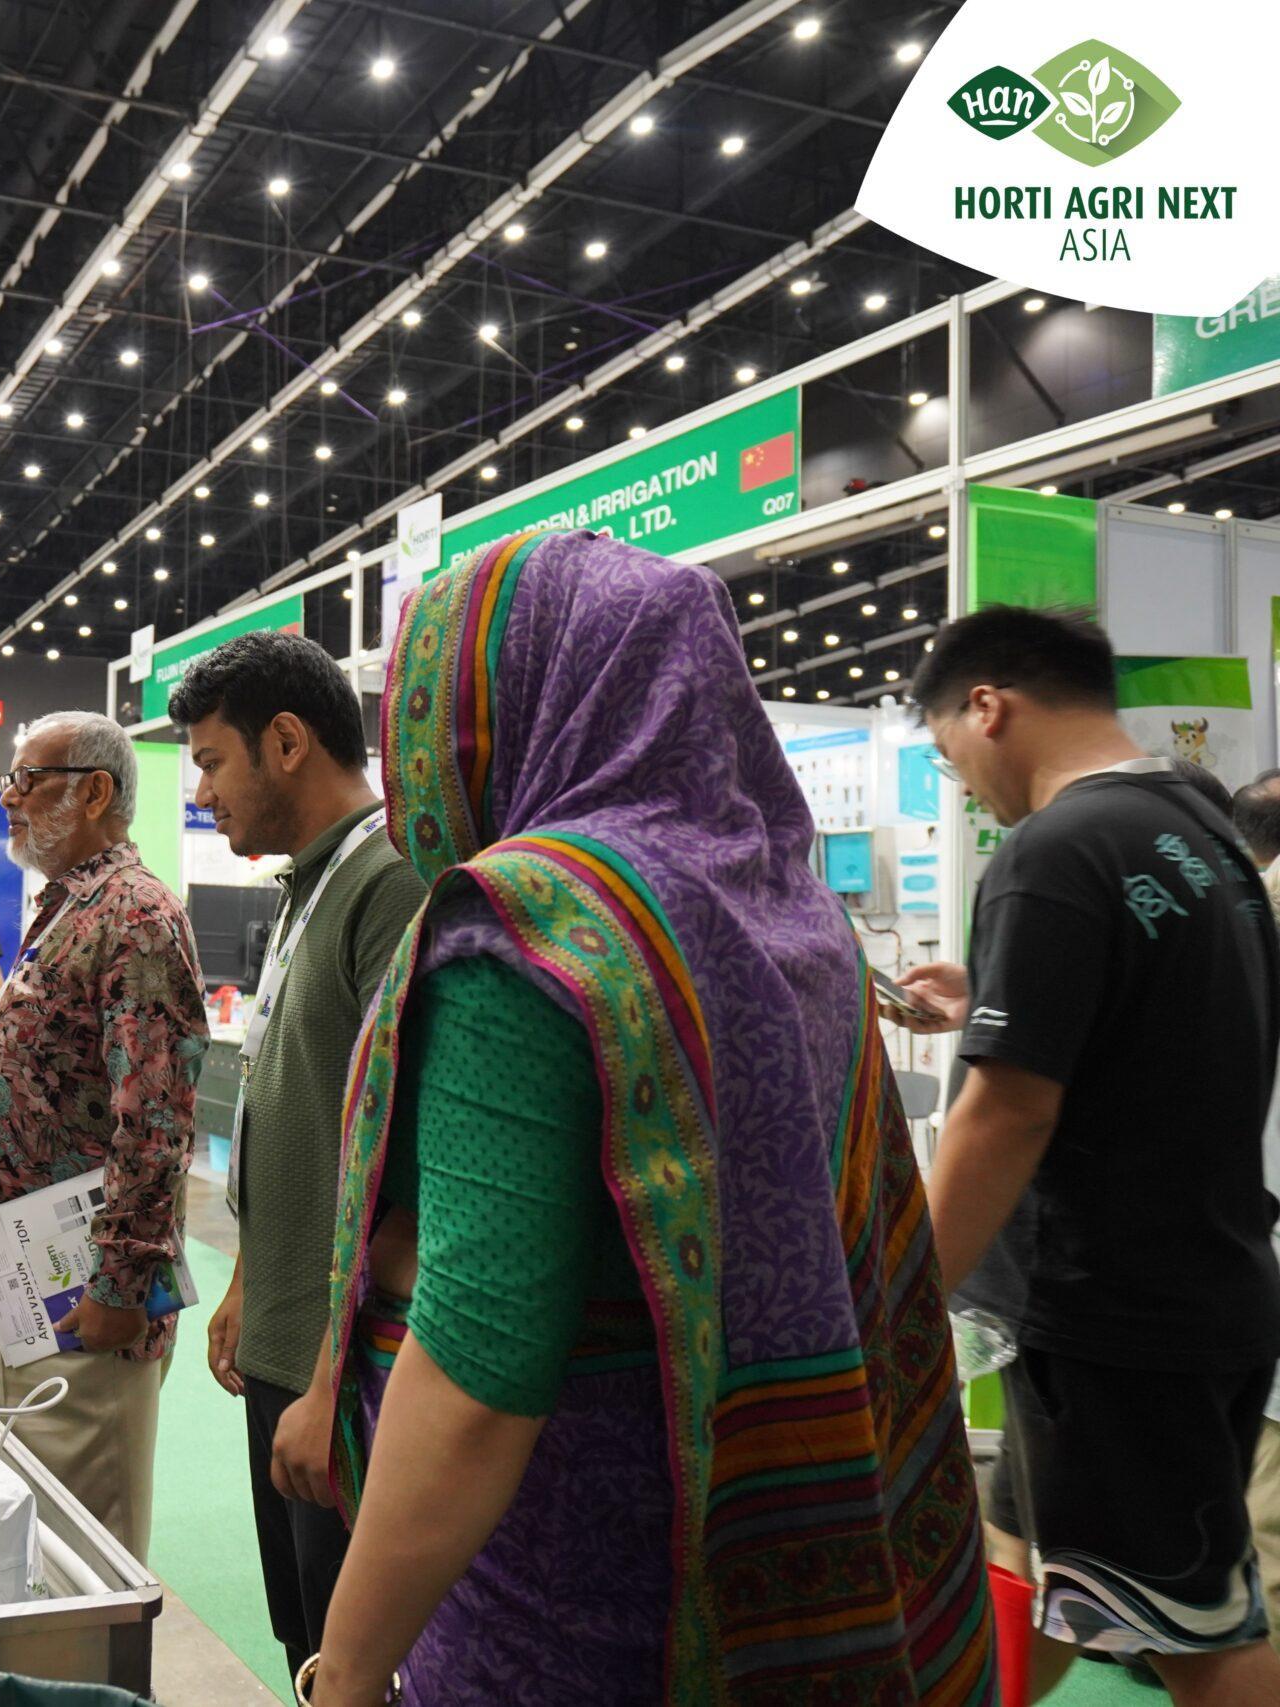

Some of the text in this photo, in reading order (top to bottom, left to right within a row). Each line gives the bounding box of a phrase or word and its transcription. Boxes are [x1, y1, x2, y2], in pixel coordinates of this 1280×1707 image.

[762, 492, 794, 517] Q07
[629, 505, 677, 540] LTD.
[46, 1245, 64, 1275] HORTI
